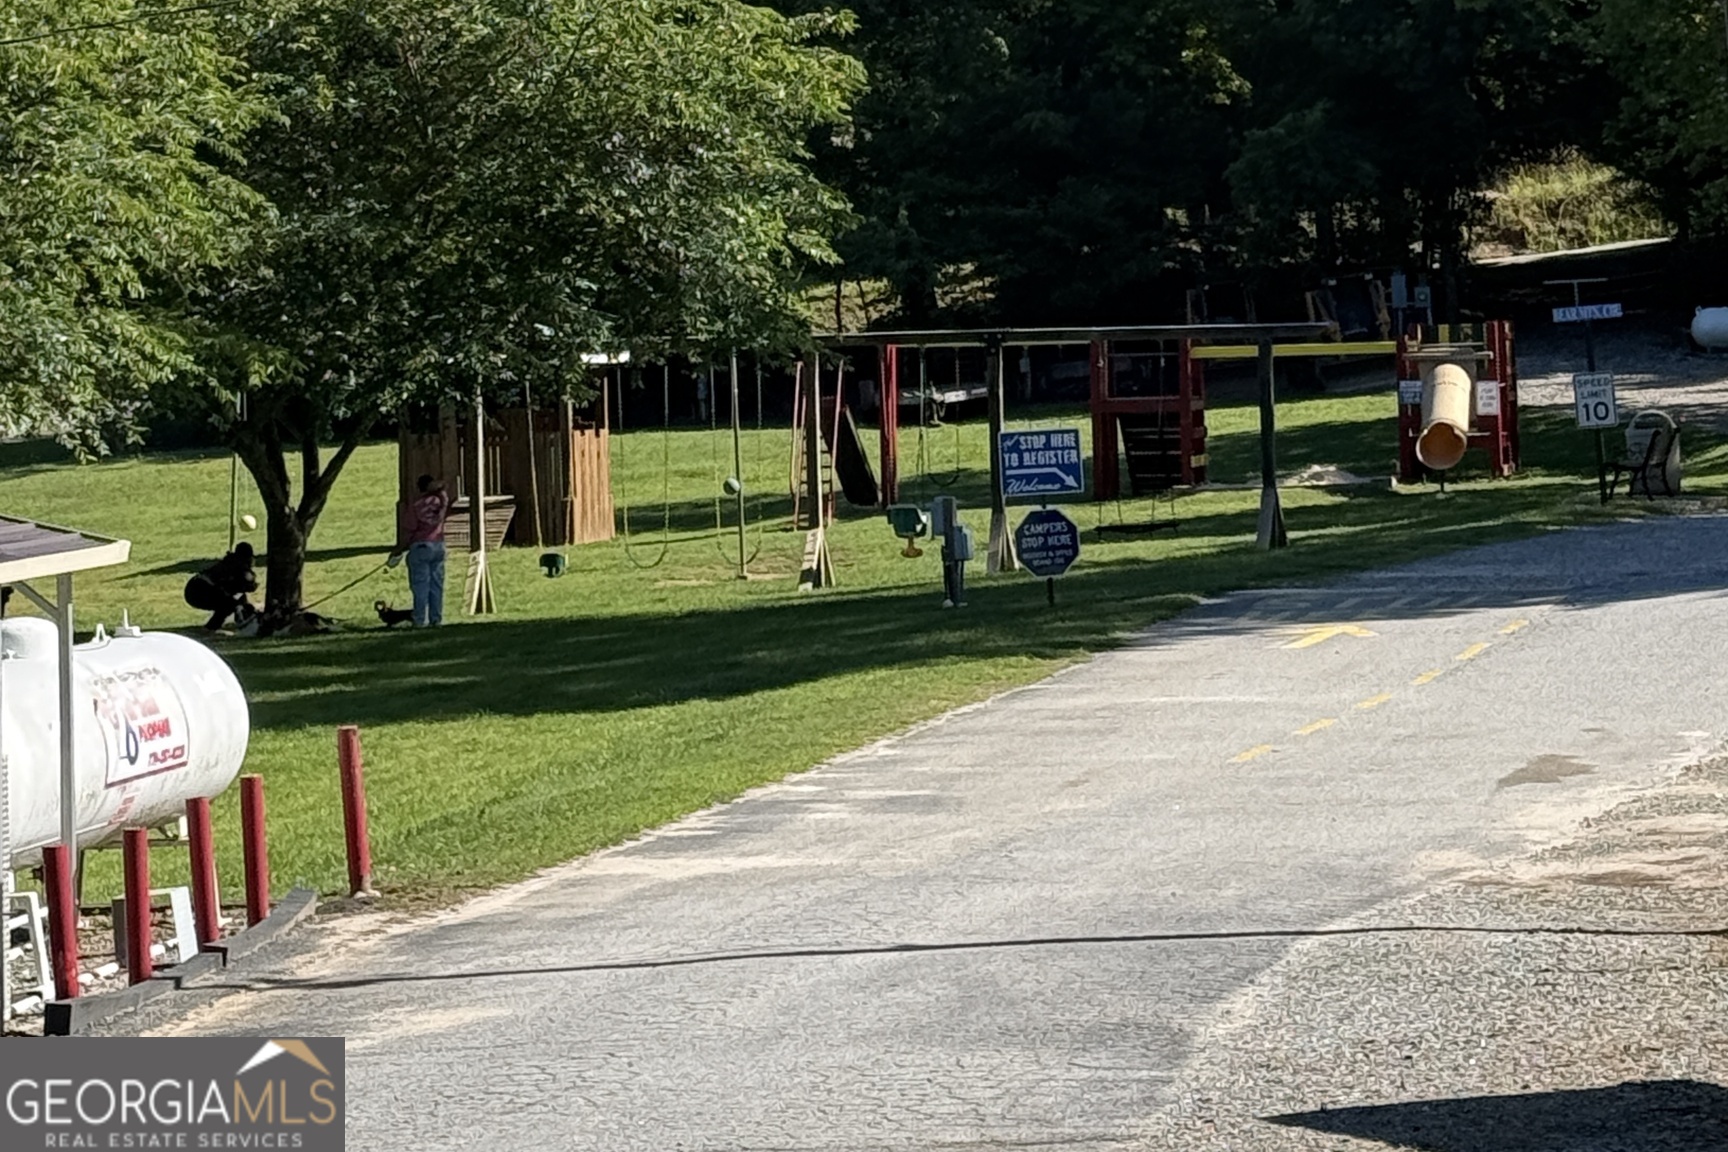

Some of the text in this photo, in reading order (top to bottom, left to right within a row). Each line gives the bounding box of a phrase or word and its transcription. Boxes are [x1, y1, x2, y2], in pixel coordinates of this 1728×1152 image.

[1577, 377, 1610, 389] SPEED
[1580, 389, 1607, 400] LIMIT
[1582, 401, 1609, 422] 10
[1019, 432, 1077, 450] STOP HERE
[1003, 449, 1079, 468] TO REGISTER
[1006, 477, 1062, 494] Welcome
[1023, 521, 1069, 536] CAMPERS
[1021, 533, 1073, 549] STOP HERE
